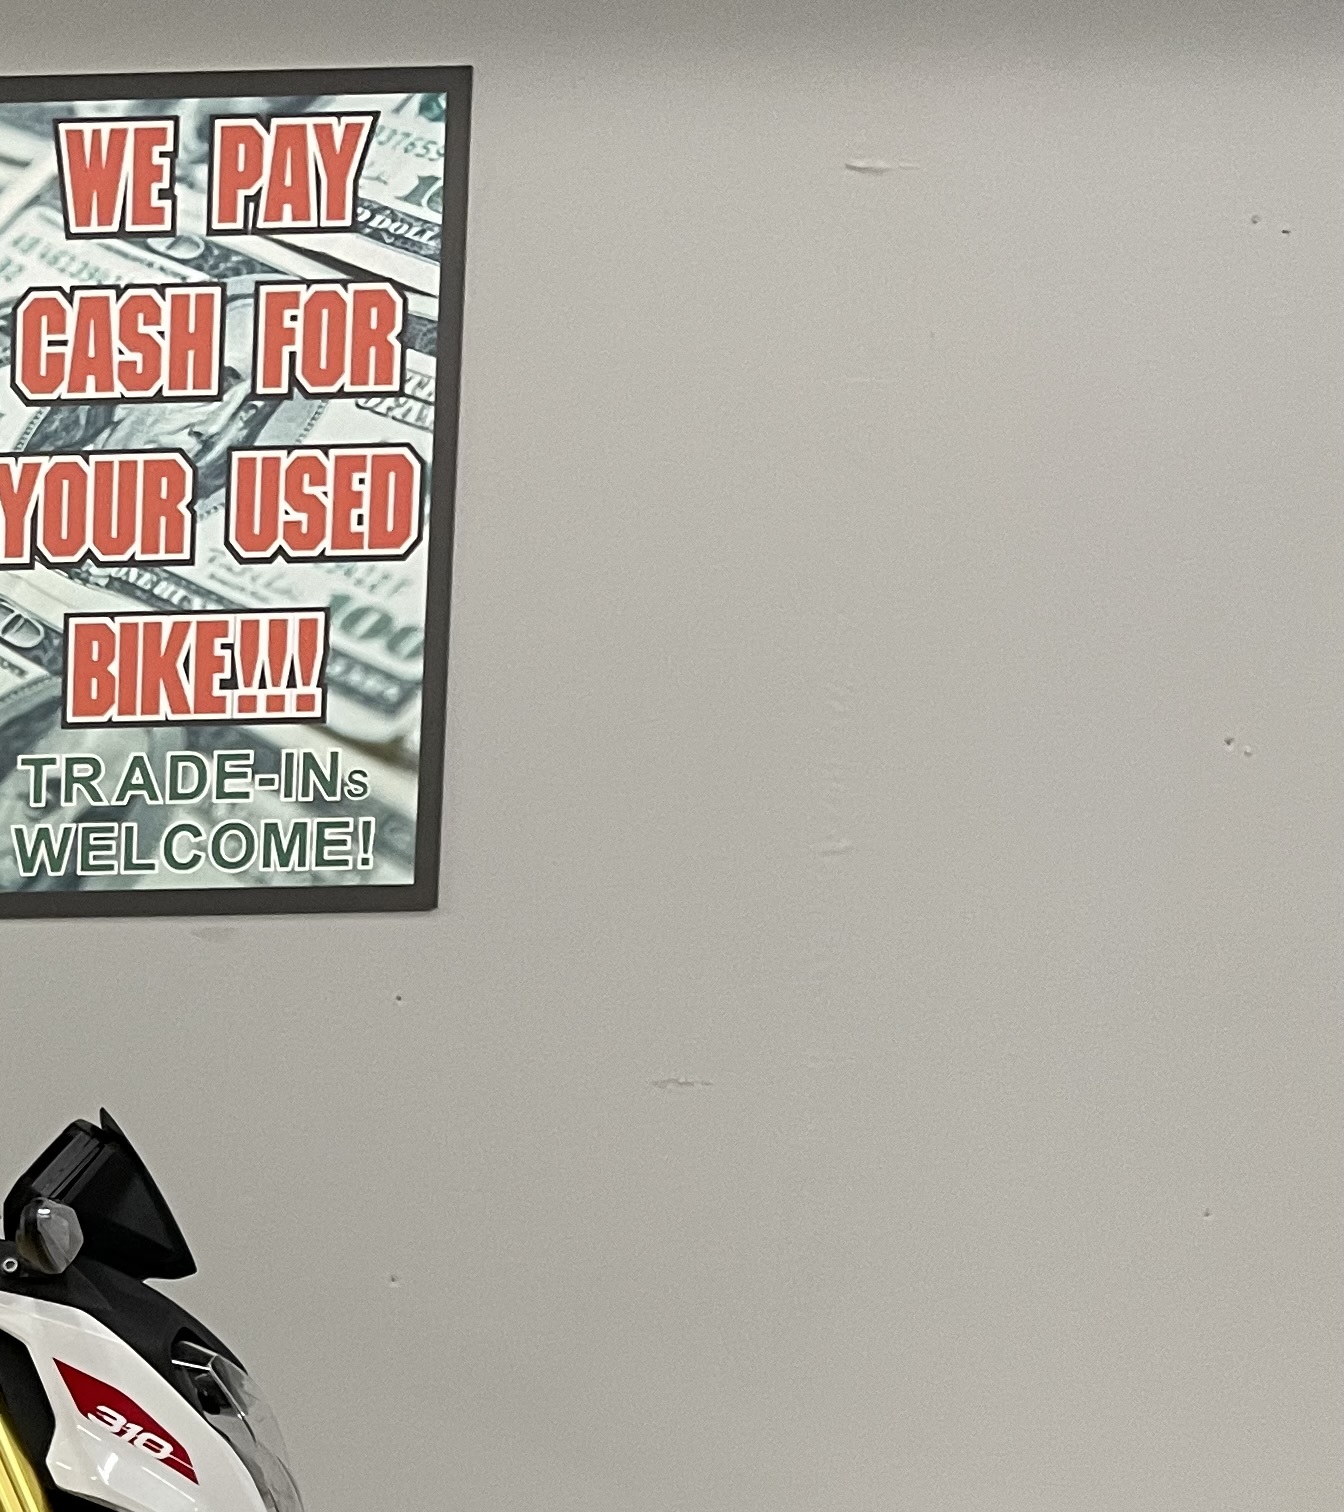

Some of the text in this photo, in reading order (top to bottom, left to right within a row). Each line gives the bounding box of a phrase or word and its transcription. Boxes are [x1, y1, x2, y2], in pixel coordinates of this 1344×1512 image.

[60, 117, 369, 232] WE PAY
[16, 283, 401, 399] CASH FOR
[230, 448, 419, 557] USED
[67, 613, 323, 722] BIKE!!!
[12, 818, 374, 876] WELCOME!
[88, 1405, 173, 1460] 310
